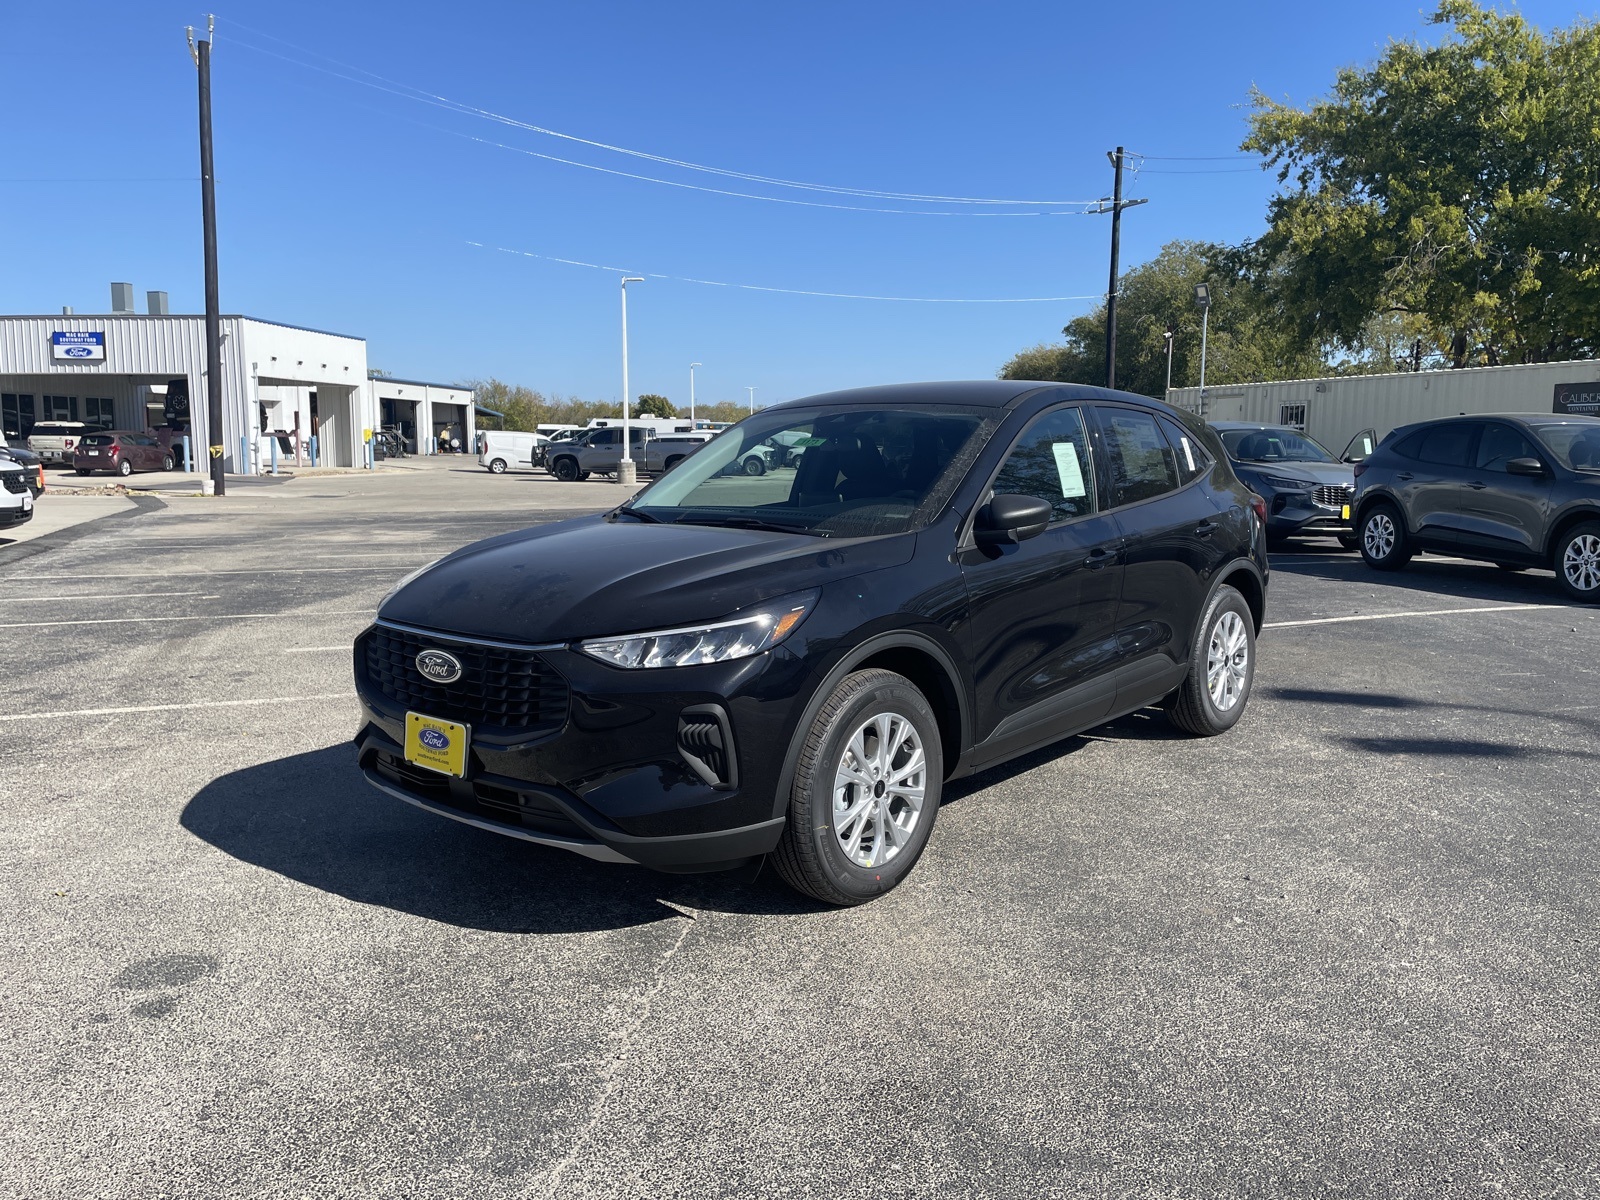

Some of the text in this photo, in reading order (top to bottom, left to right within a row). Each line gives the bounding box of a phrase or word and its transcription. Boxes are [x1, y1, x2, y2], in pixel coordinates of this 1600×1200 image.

[69, 348, 87, 357] Ford
[423, 656, 448, 677] Ford
[423, 731, 444, 747] Ford
[417, 753, 449, 765] southwayford.com
